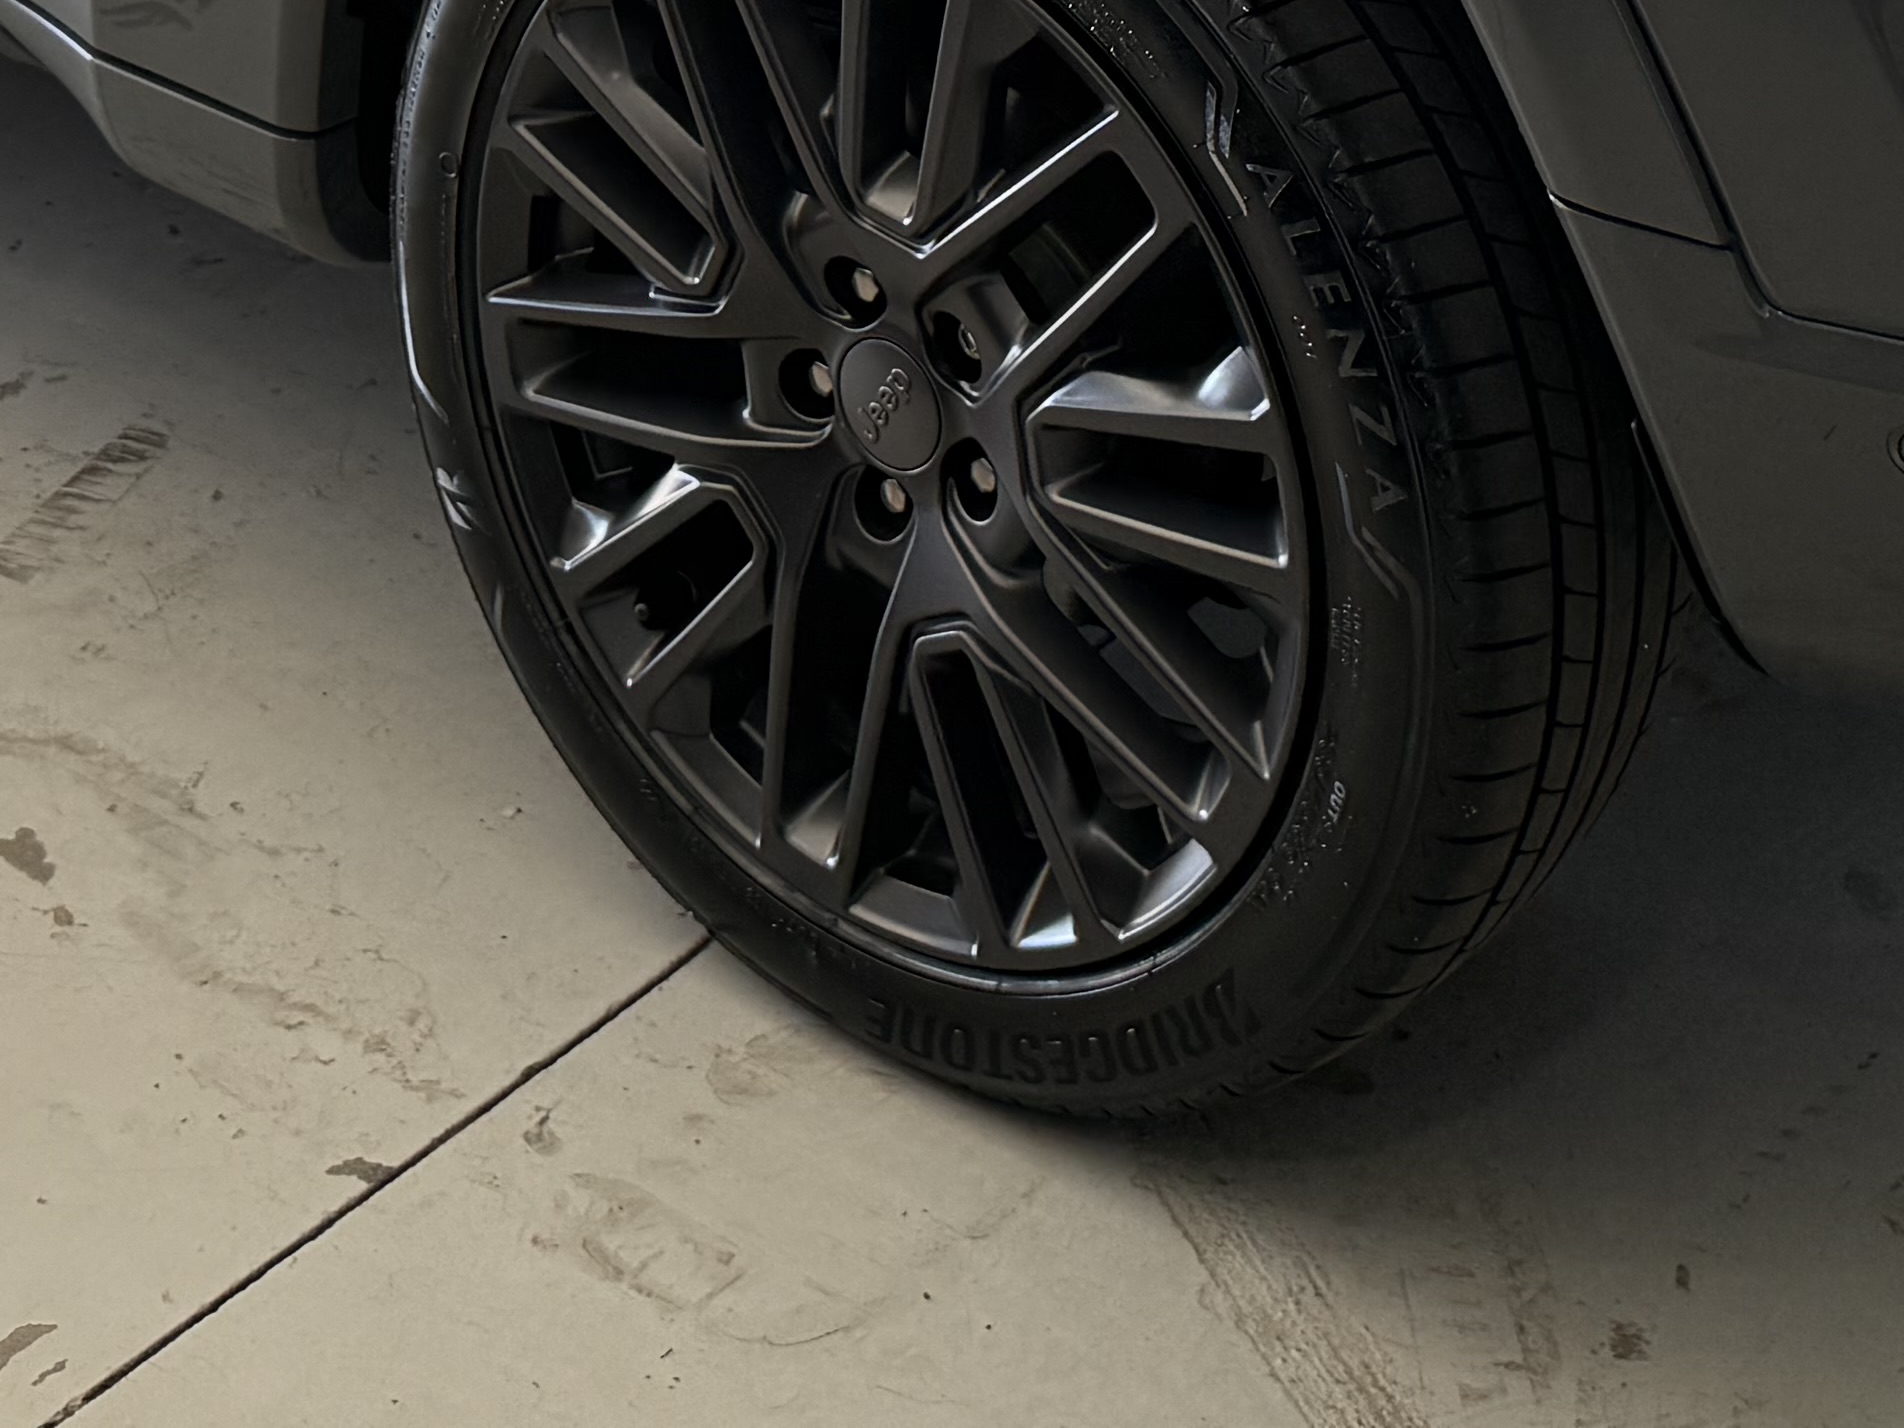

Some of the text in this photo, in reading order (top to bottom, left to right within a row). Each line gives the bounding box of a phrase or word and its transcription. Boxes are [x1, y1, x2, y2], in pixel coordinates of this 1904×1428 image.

[1224, 162, 1407, 514] ALENZA
[857, 367, 912, 444] Jeep
[863, 966, 1265, 1087] BRIDGESTONE
